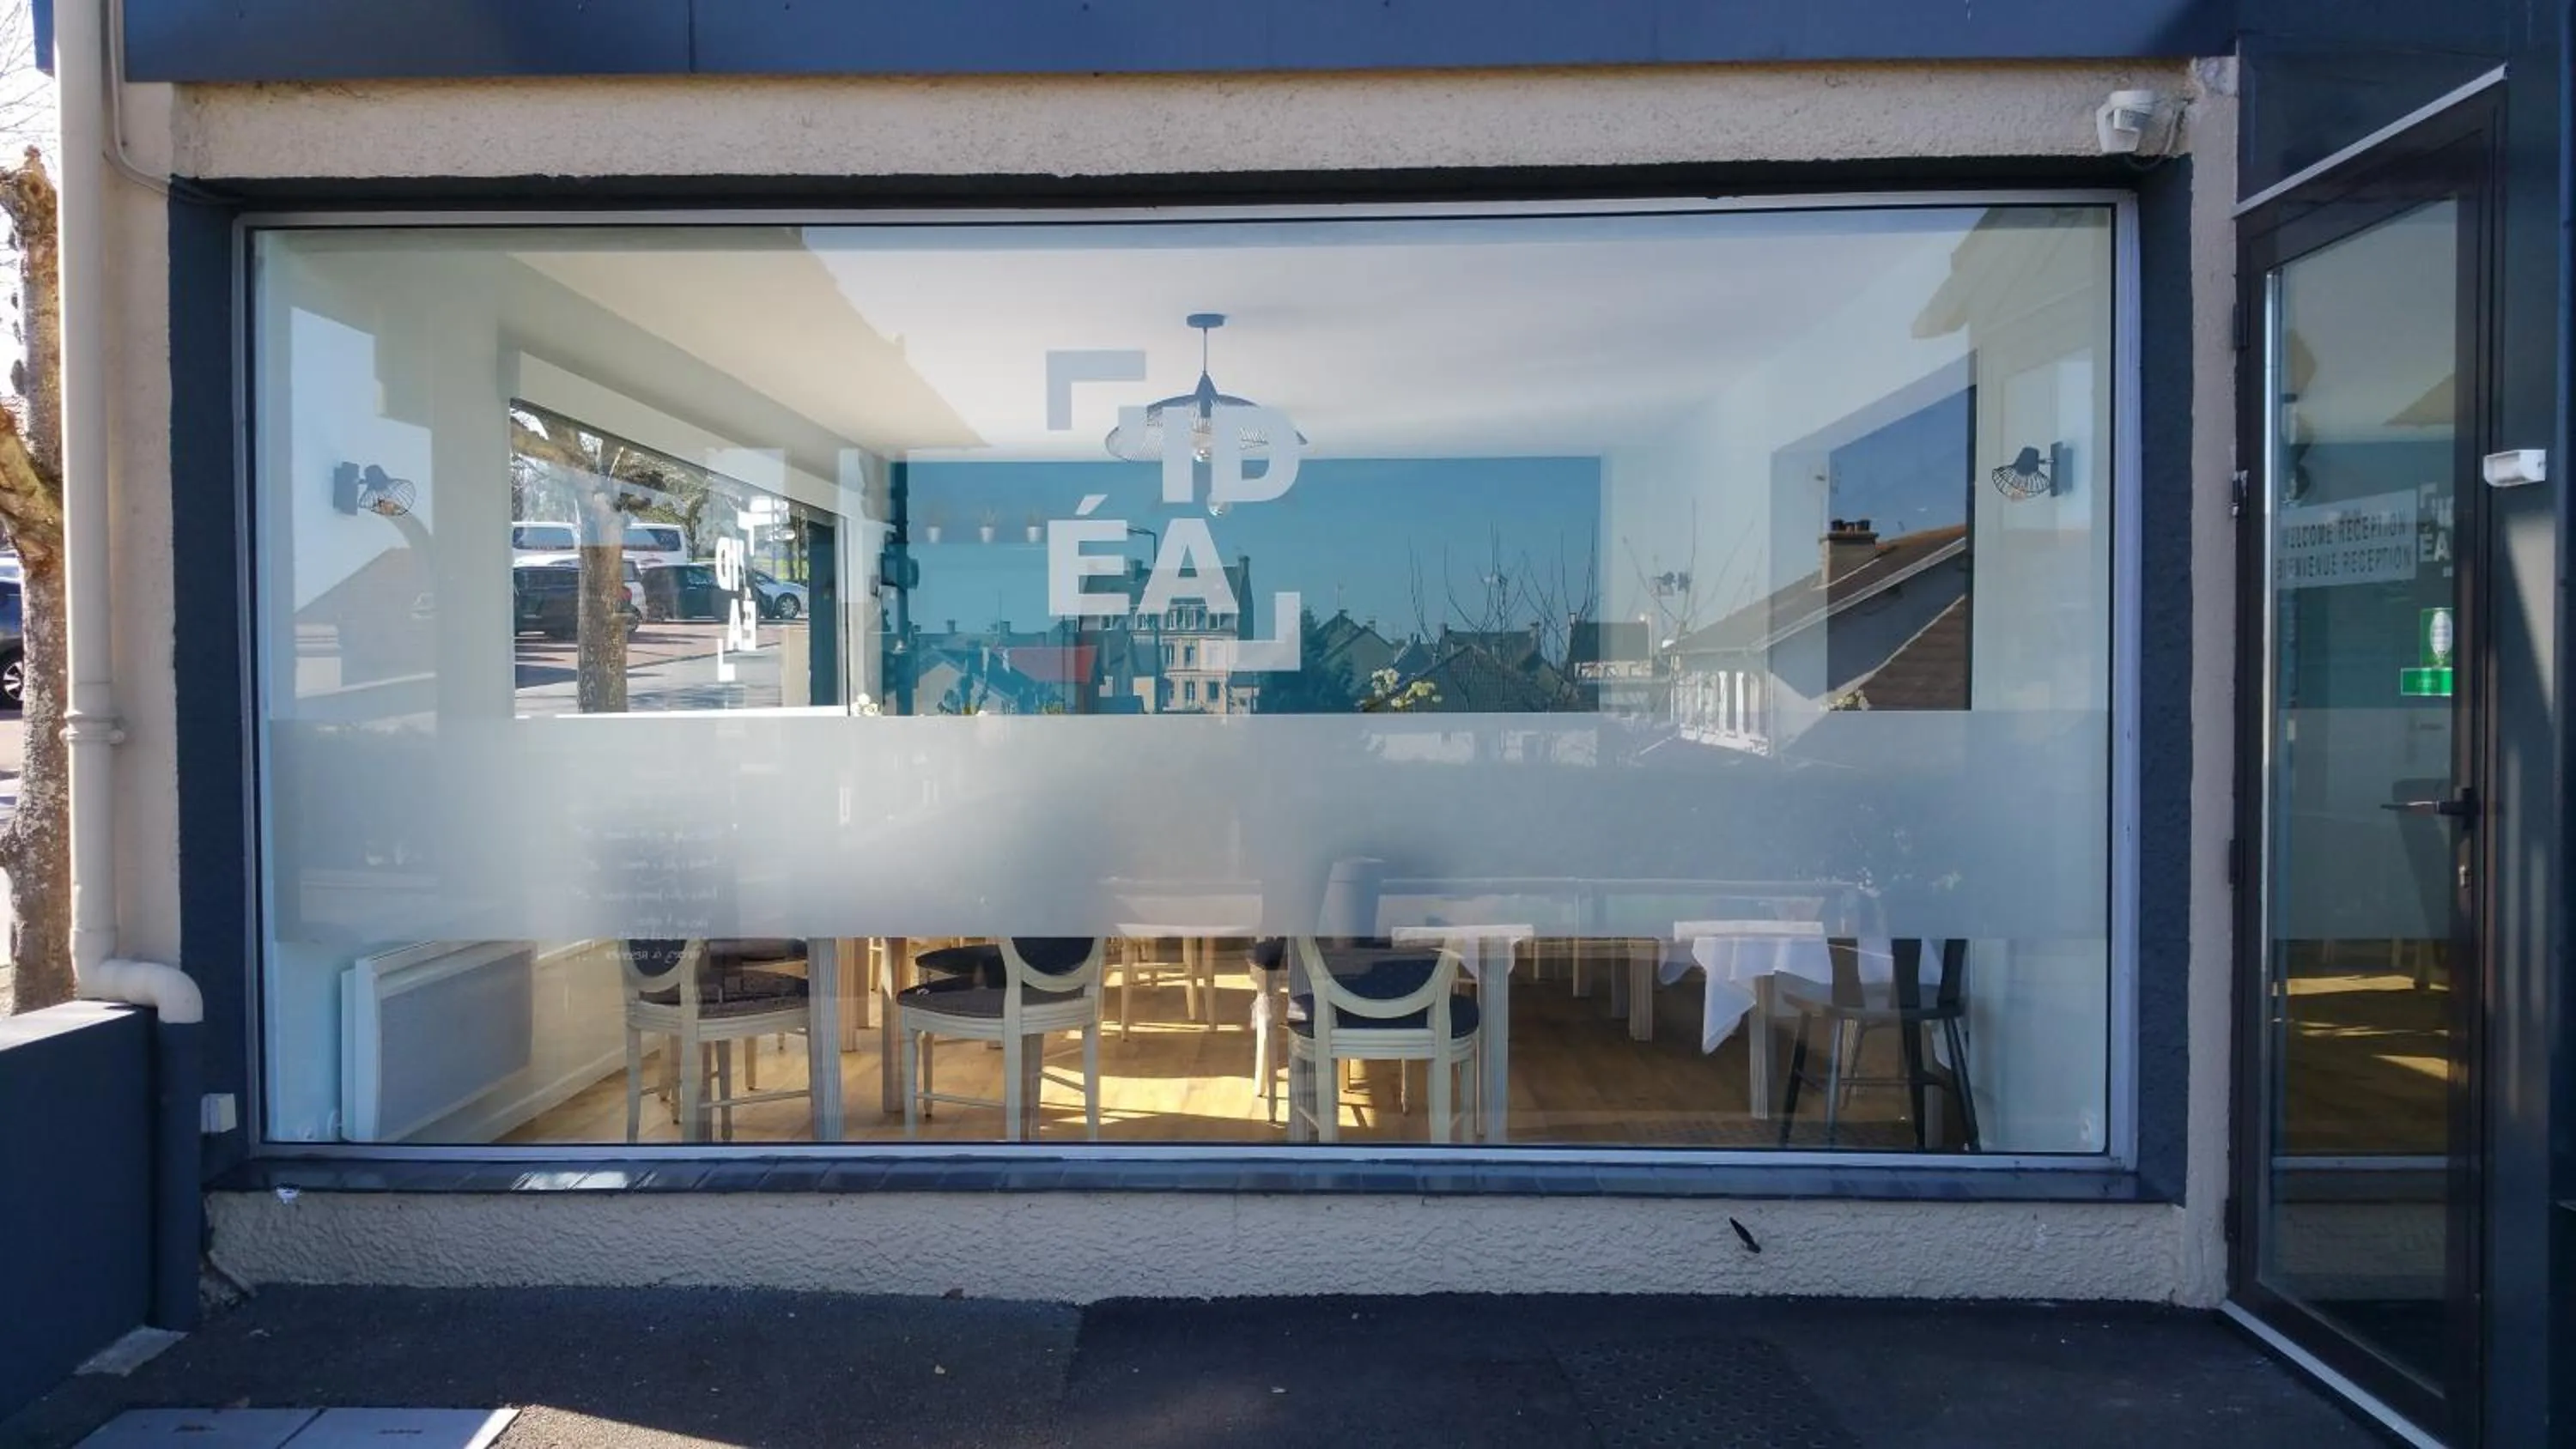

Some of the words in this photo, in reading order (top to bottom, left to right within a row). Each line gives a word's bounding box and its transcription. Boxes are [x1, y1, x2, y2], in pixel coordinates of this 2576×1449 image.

[1162, 407, 1300, 502] ID
[2338, 508, 2407, 543] RECEPTION
[2342, 545, 2412, 574] RECEPTION
